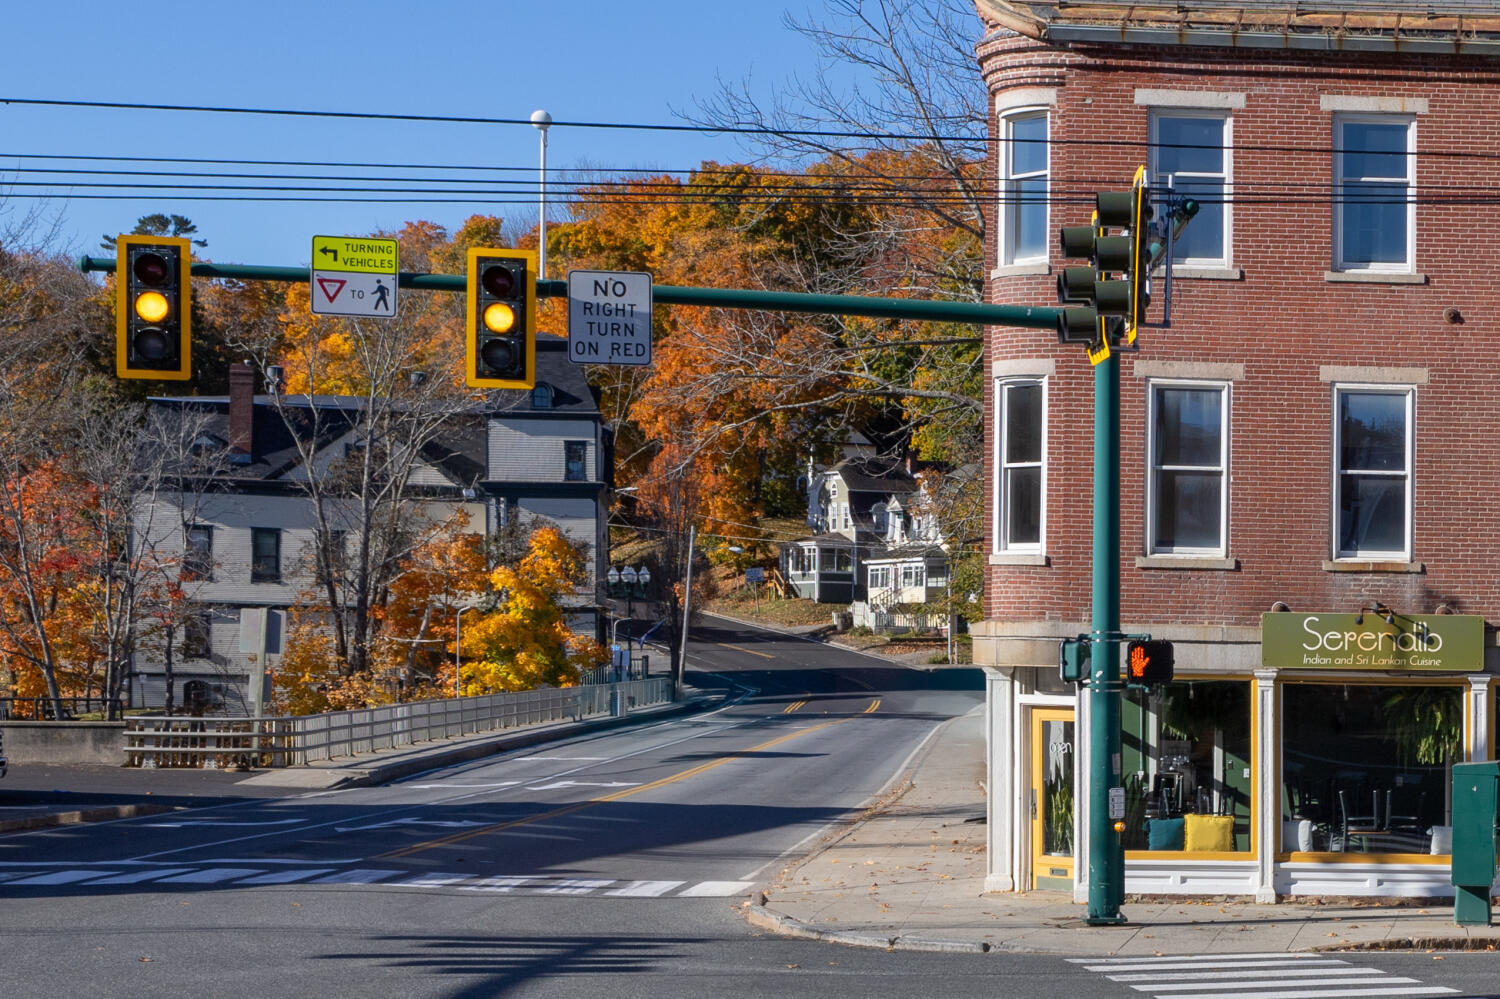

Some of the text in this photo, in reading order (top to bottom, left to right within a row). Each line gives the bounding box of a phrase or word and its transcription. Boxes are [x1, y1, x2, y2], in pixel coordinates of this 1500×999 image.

[344, 243, 393, 255] TURNING
[342, 257, 394, 269] VEHICLES
[350, 289, 365, 300] TO
[593, 280, 627, 298] NO
[583, 302, 637, 317] RIGHT
[587, 322, 635, 337] TURN
[575, 341, 646, 357] ON RED
[1302, 616, 1443, 653] Serendib
[1302, 653, 1442, 666] Indian and Sri Lankan Cuisine
